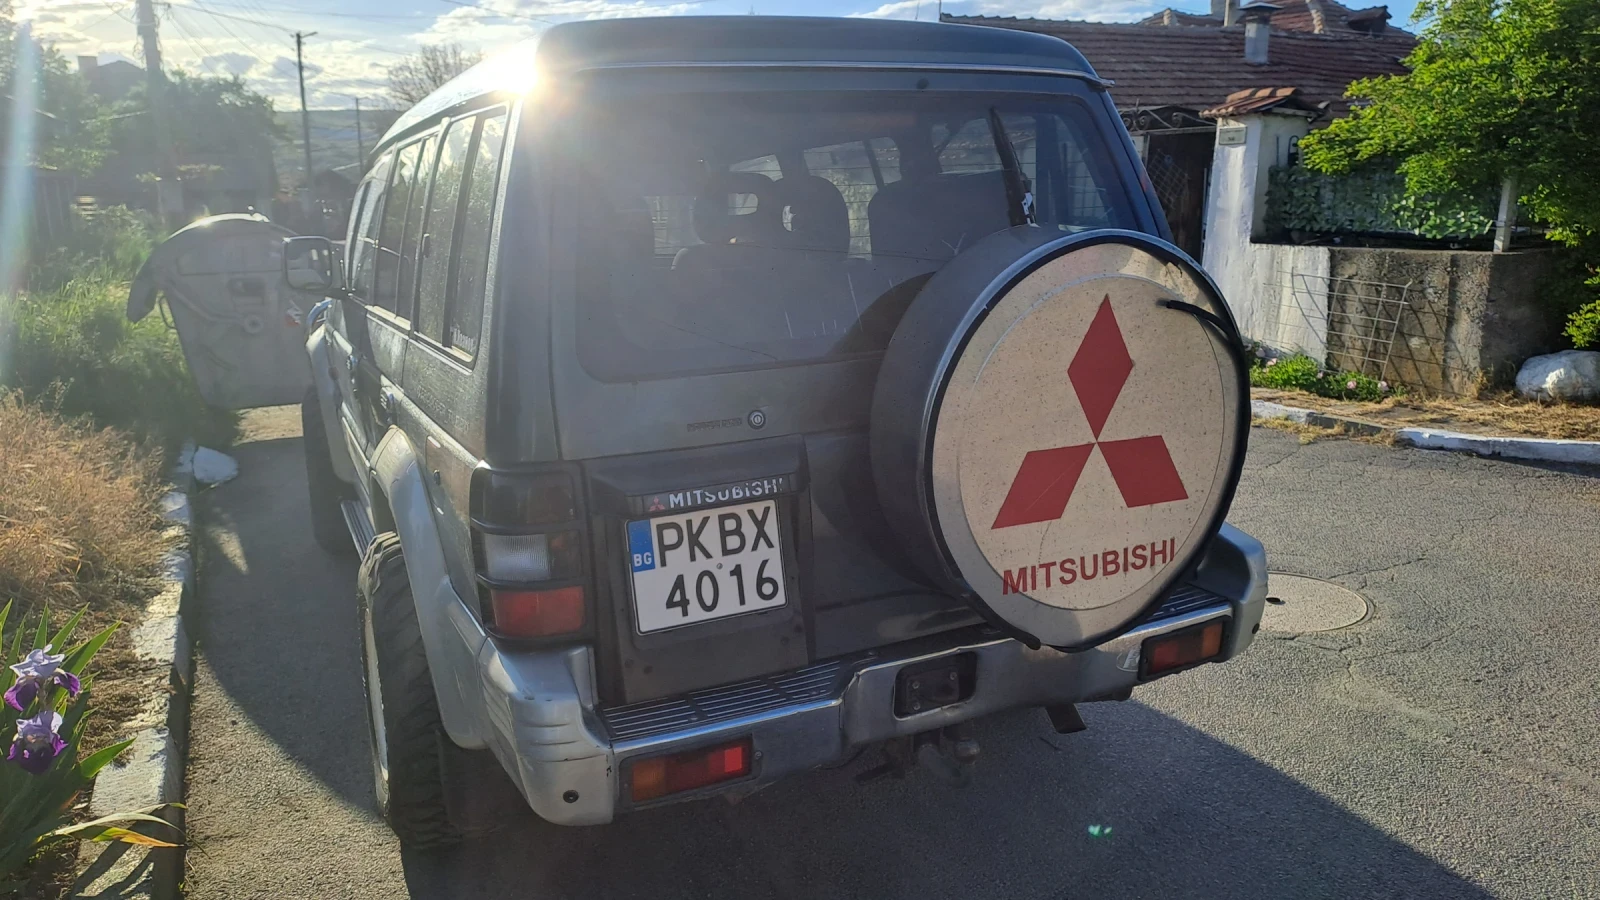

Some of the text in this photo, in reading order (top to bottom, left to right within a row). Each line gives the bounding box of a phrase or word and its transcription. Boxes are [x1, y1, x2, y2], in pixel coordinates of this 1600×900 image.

[633, 551, 652, 567] BG
[656, 506, 774, 568] PKBX
[1002, 536, 1175, 596] MITSUBISHI
[666, 559, 779, 617] 4016
